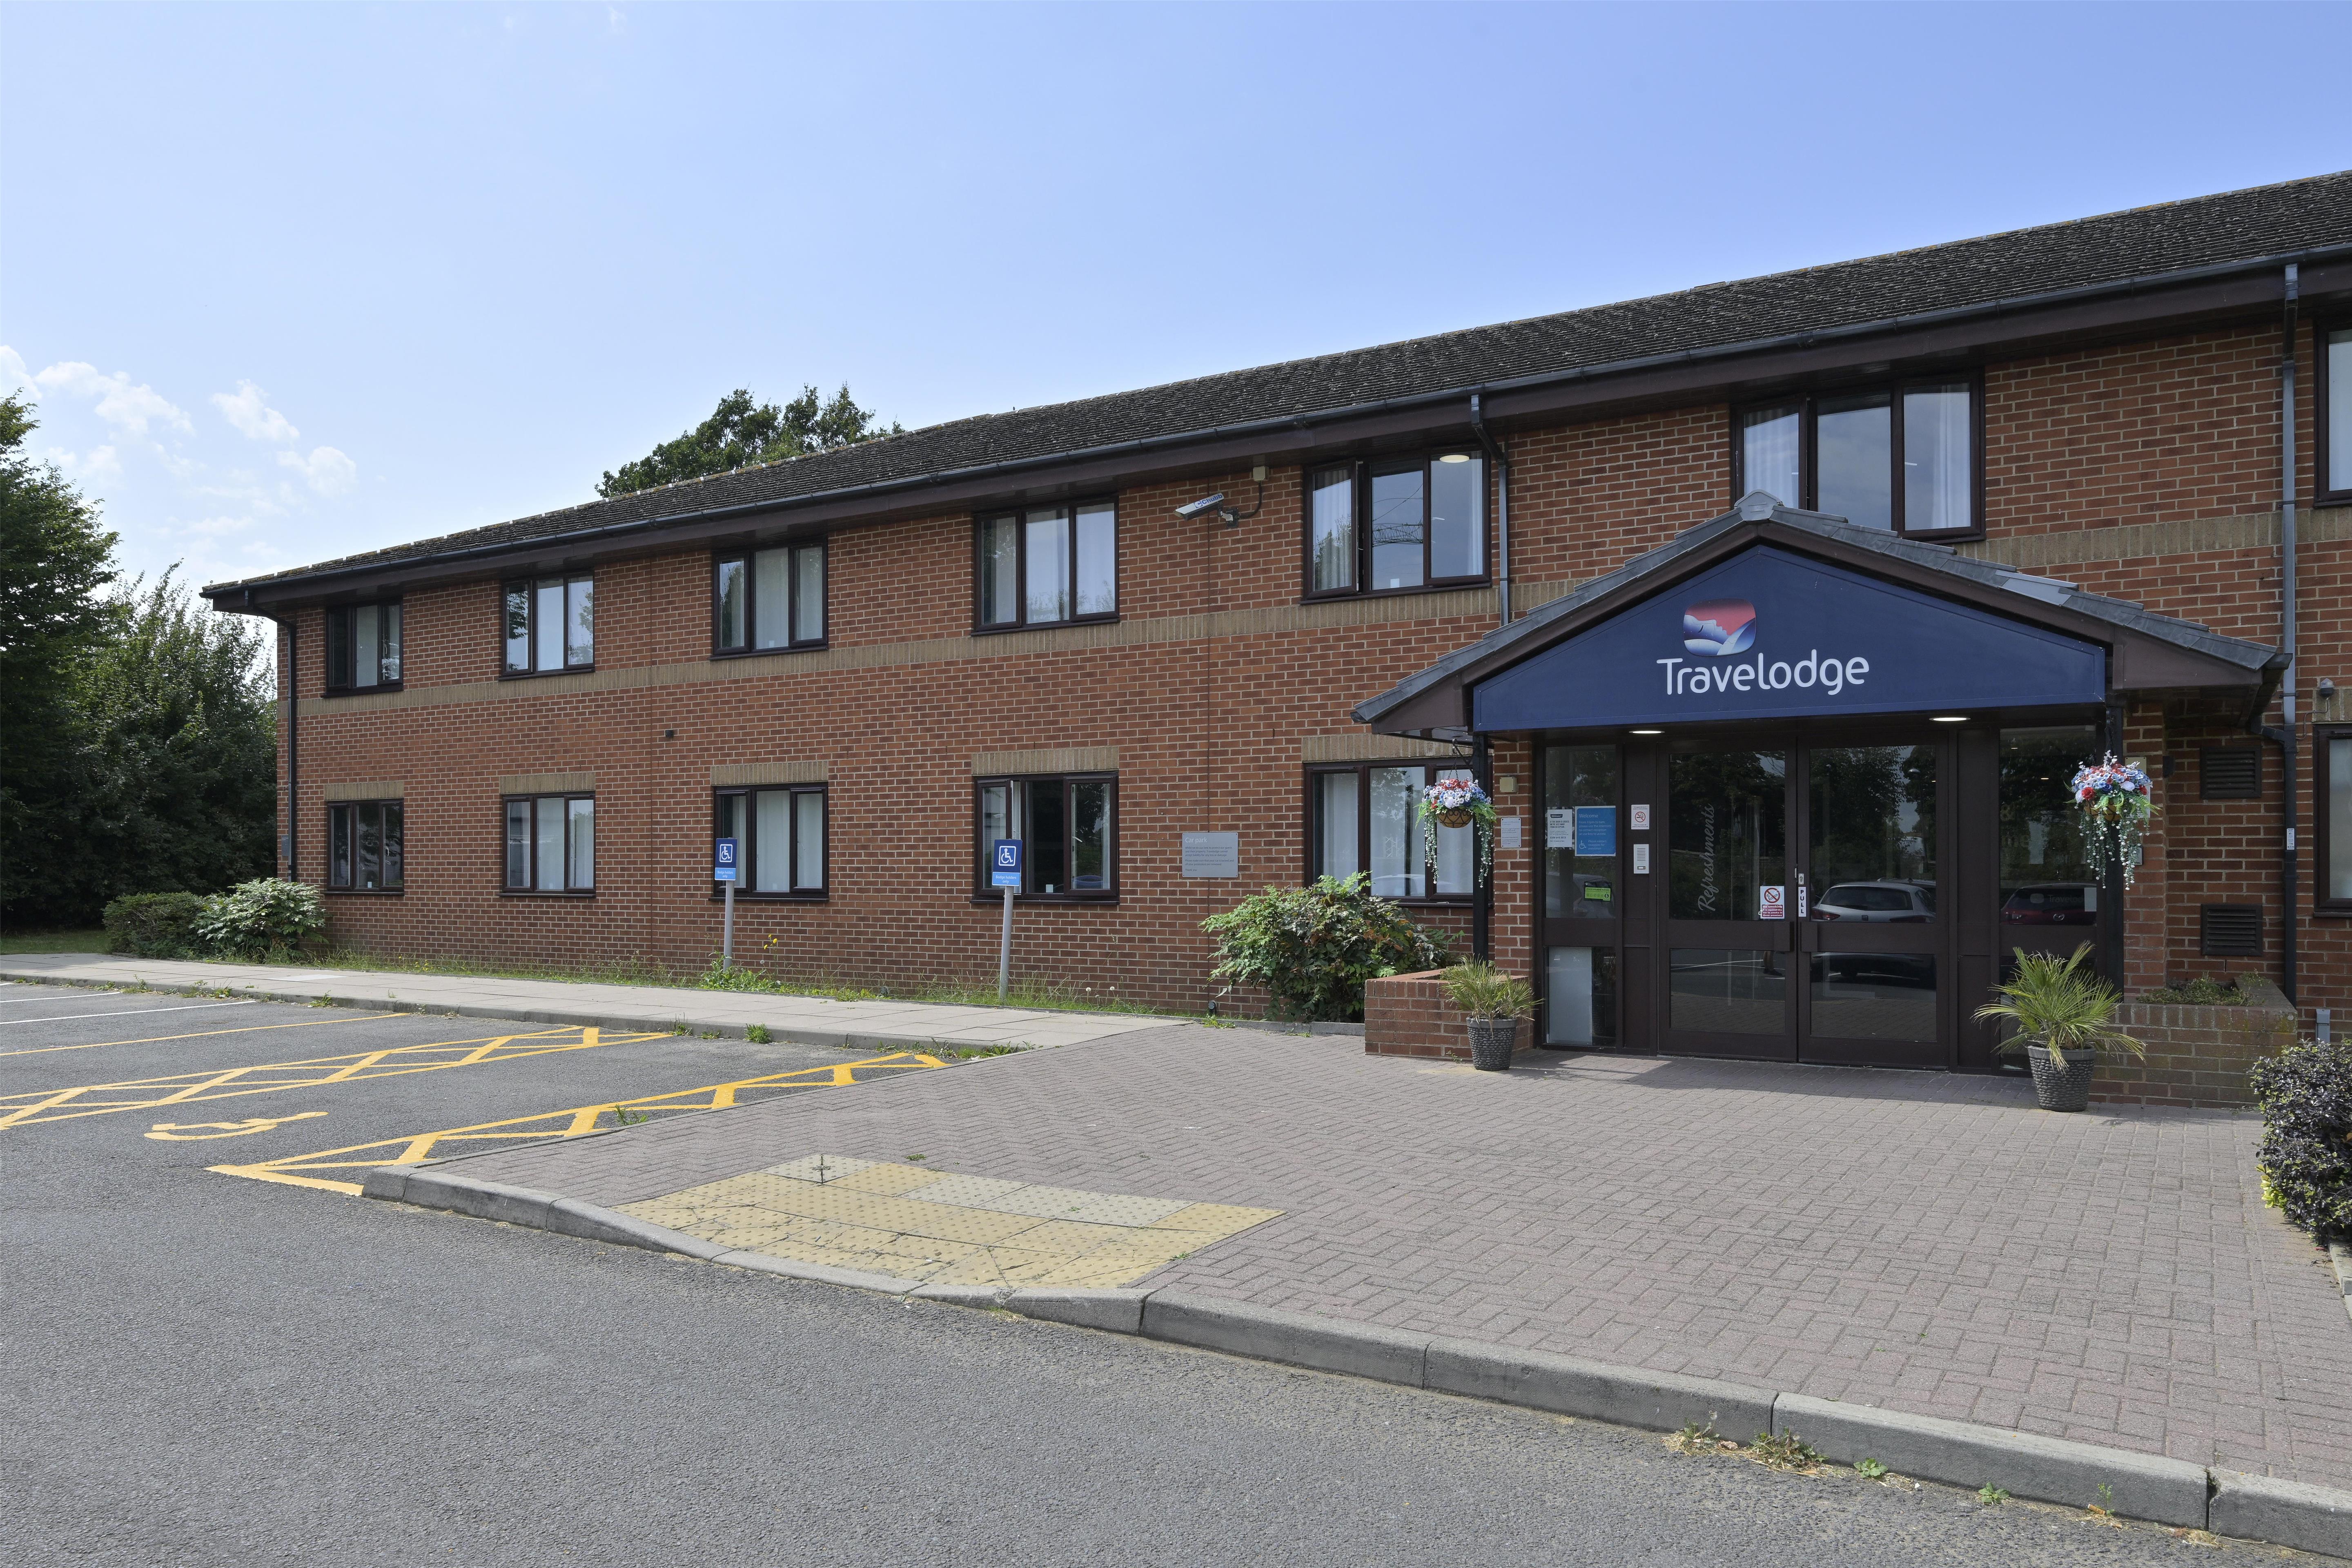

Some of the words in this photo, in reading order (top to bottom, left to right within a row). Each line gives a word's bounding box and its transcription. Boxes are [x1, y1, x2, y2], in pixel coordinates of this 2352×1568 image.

[1202, 494, 1223, 504] Chubb
[1657, 649, 1869, 695] Travelodge
[1698, 803, 1719, 911] Refreshments
